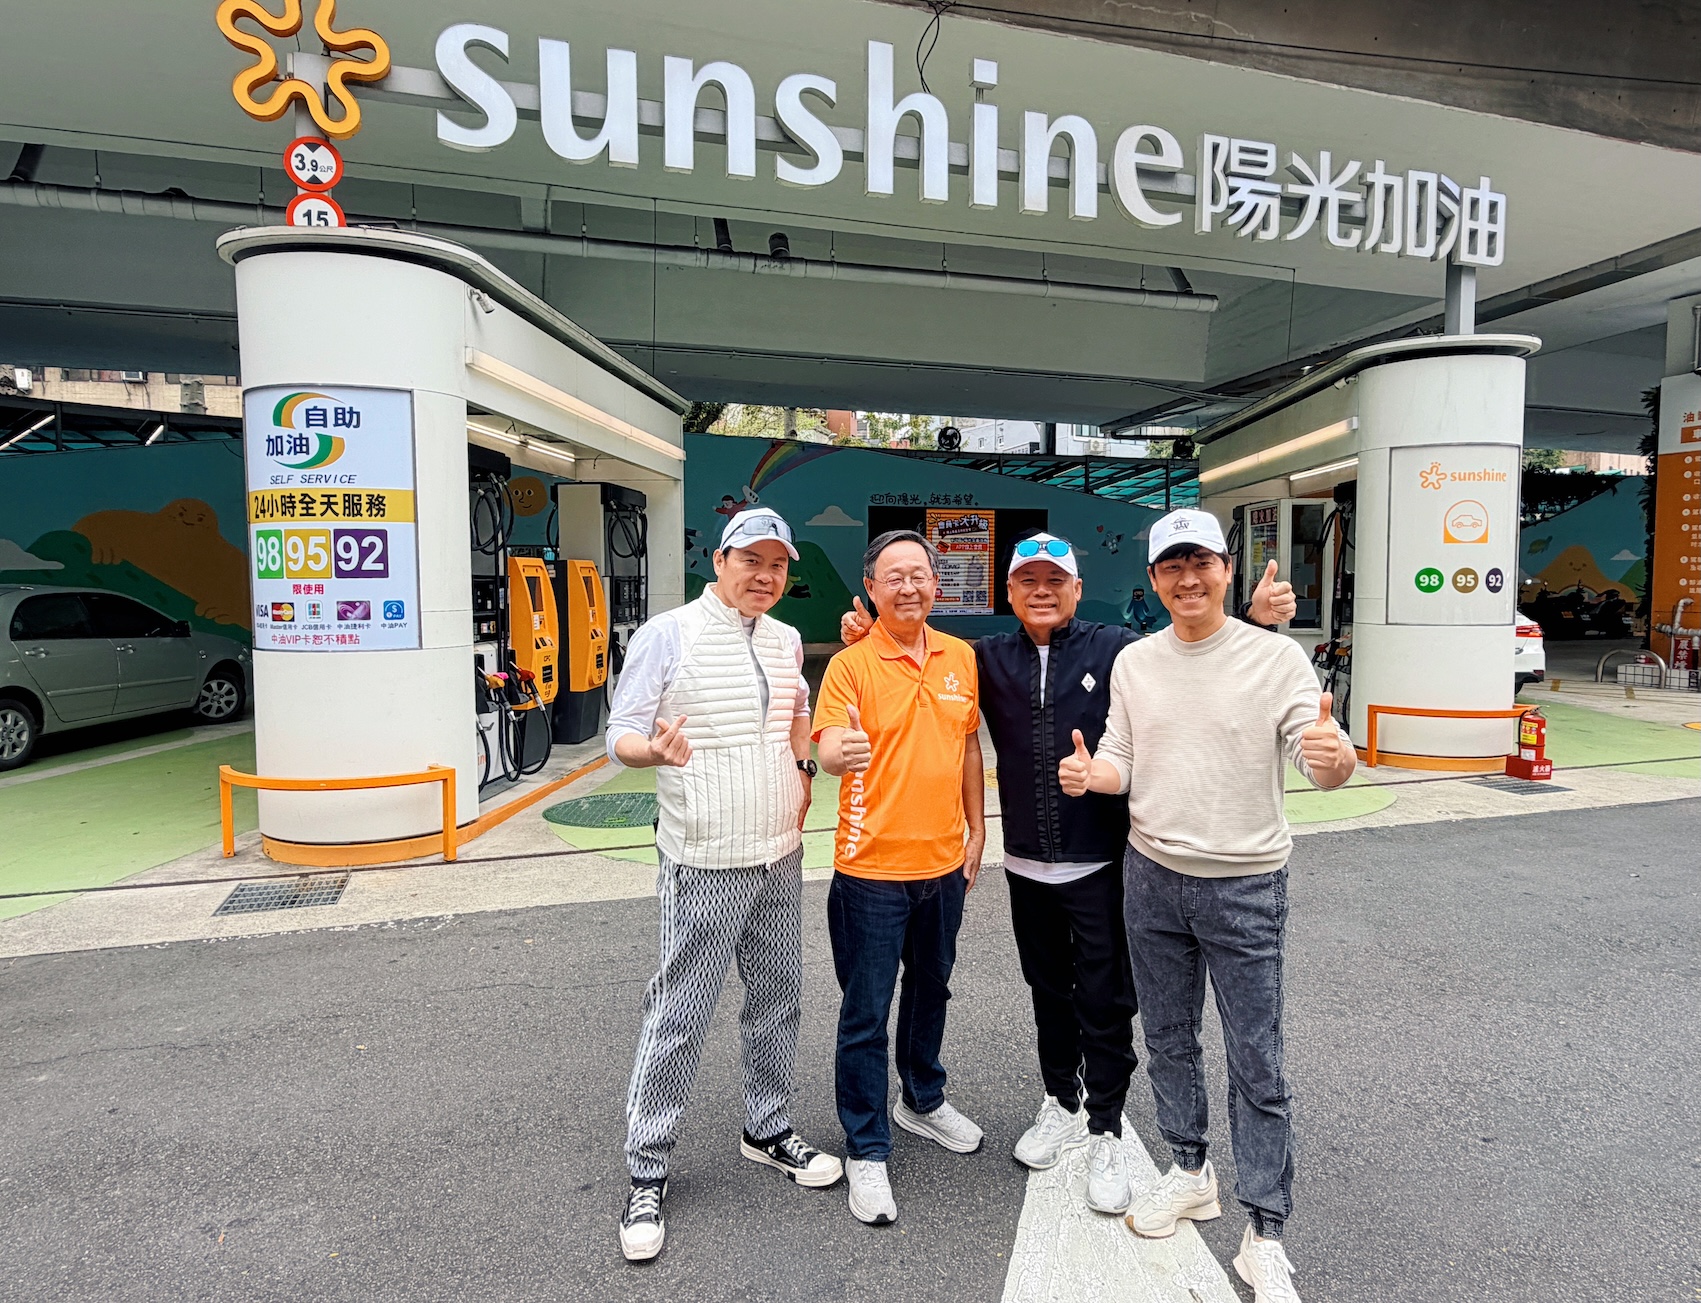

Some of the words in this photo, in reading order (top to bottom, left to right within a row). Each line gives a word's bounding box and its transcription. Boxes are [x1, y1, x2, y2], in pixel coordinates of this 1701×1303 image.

[433, 22, 1184, 229] sunshine
[1195, 131, 1507, 268] 陽光加油
[302, 209, 329, 226] 15
[304, 405, 361, 429] 自助
[265, 432, 311, 457] 加油
[269, 475, 294, 485] SELF
[300, 474, 357, 484] SERVICE
[1450, 468, 1507, 482] sunshine
[254, 493, 386, 519] 24小時全天服務
[257, 535, 281, 572] 98
[286, 535, 329, 571] 95
[336, 535, 385, 571] 92
[292, 583, 324, 595] 限使用
[1419, 574, 1440, 587] 98
[1456, 574, 1475, 587] 95
[1488, 574, 1502, 587] 92
[256, 604, 269, 618] VISA
[271, 633, 360, 645] 中油VIP卡恕不積點
[937, 693, 968, 703] sunshine
[844, 771, 867, 858] nshine
